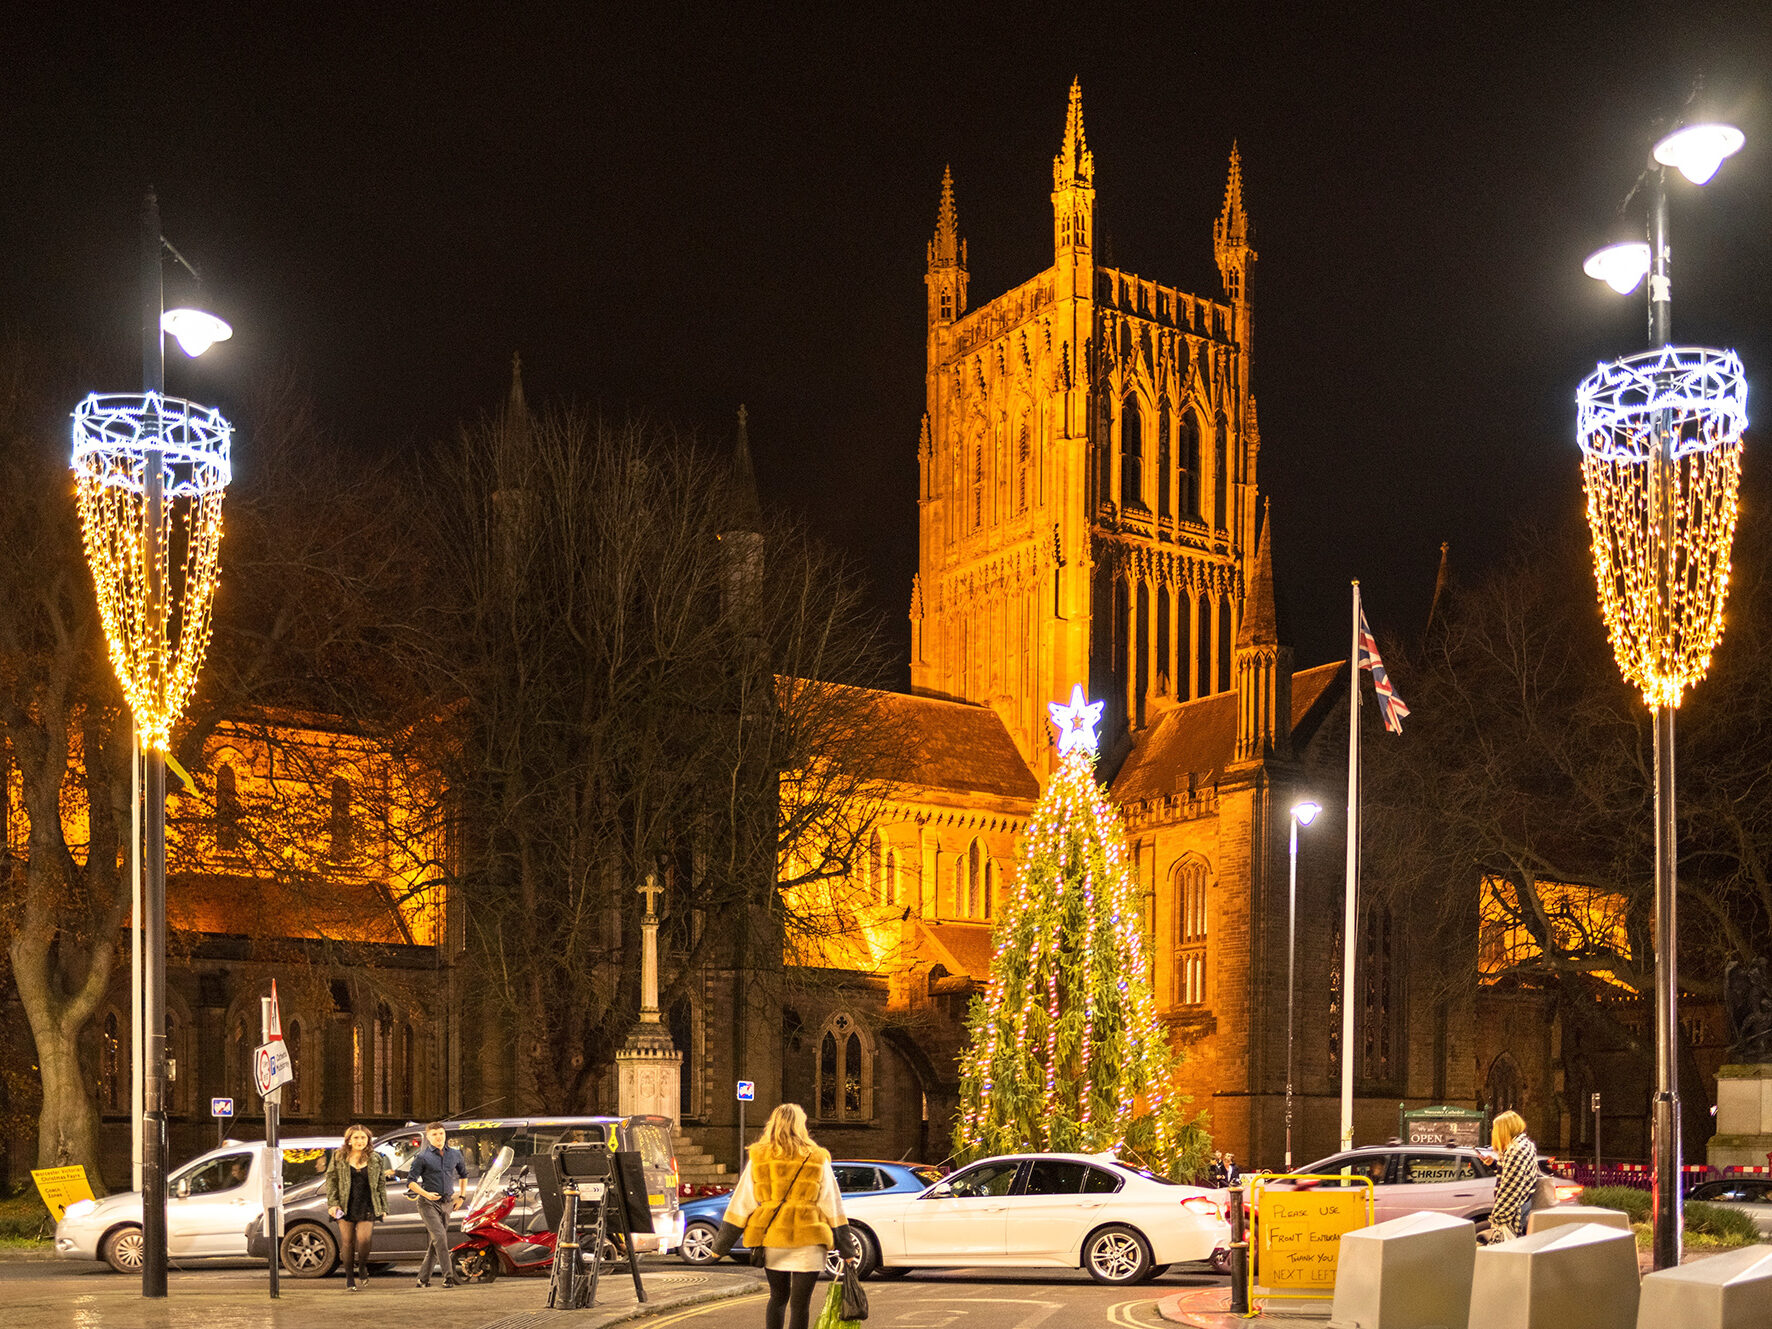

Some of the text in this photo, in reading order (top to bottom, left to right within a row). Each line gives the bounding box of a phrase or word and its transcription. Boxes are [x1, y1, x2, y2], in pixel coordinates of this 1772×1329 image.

[458, 1121, 503, 1130] TAXI
[1410, 1134, 1443, 1143] OPEN
[1319, 1206, 1341, 1216] USE
[1273, 1269, 1337, 1281] NEXT LEFT
